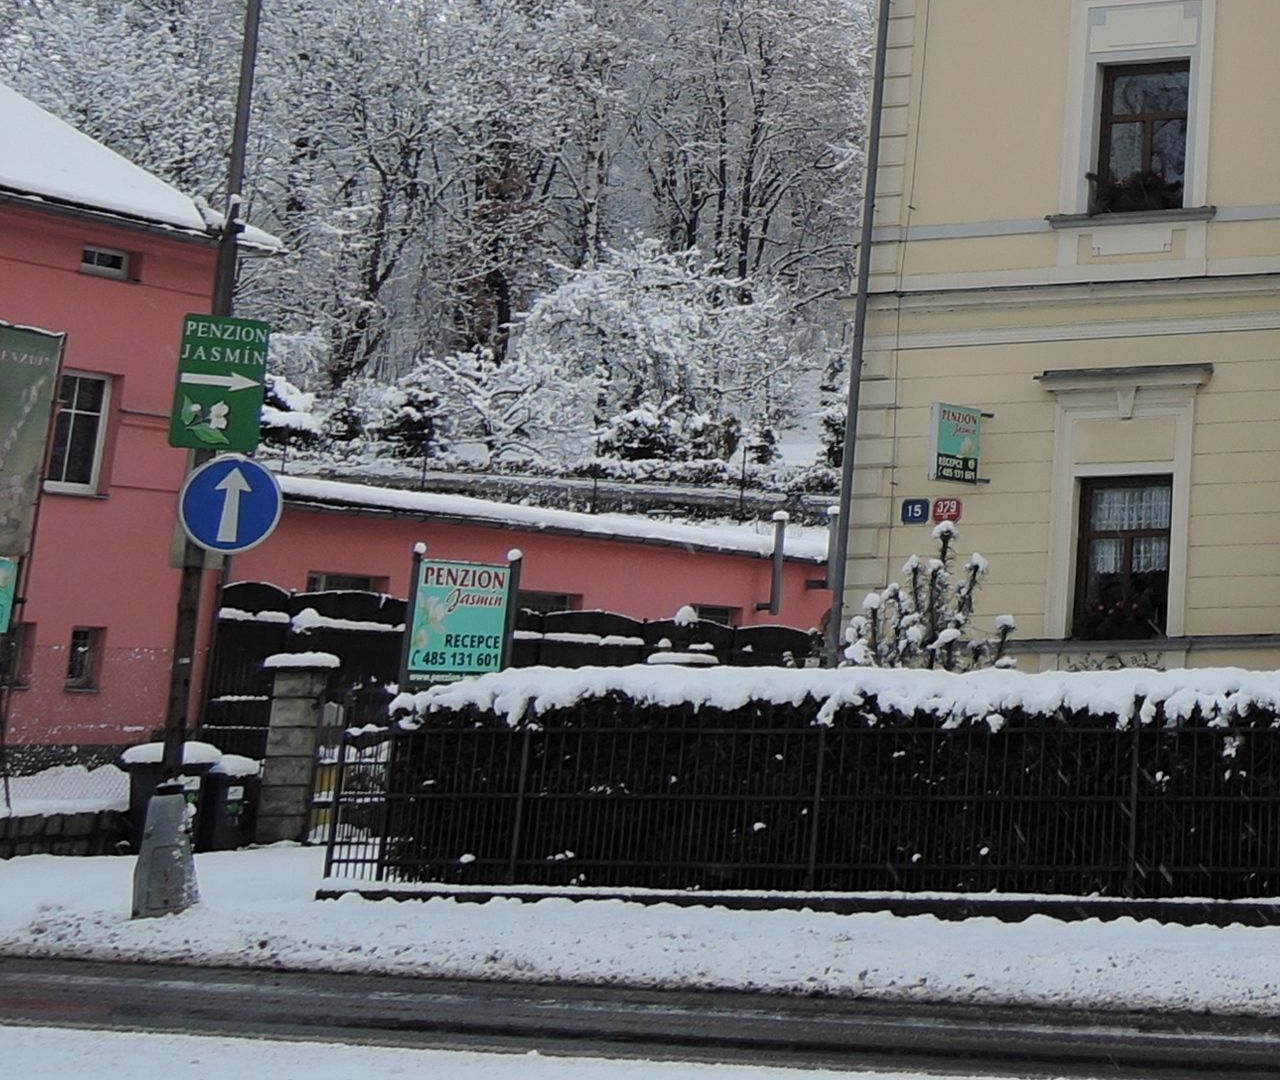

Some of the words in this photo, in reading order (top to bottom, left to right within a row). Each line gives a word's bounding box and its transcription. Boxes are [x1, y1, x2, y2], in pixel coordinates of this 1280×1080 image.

[185, 321, 267, 343] PENZION
[181, 344, 265, 365] JASMÍN
[942, 409, 977, 425] PENZION
[908, 504, 922, 517] 15
[936, 500, 957, 513] 379
[424, 566, 505, 589] PENZION
[446, 588, 502, 613] Jasmín
[444, 634, 500, 649] RECEPCE
[422, 651, 446, 666] 485
[450, 652, 472, 666] 131
[476, 652, 498, 667] 601
